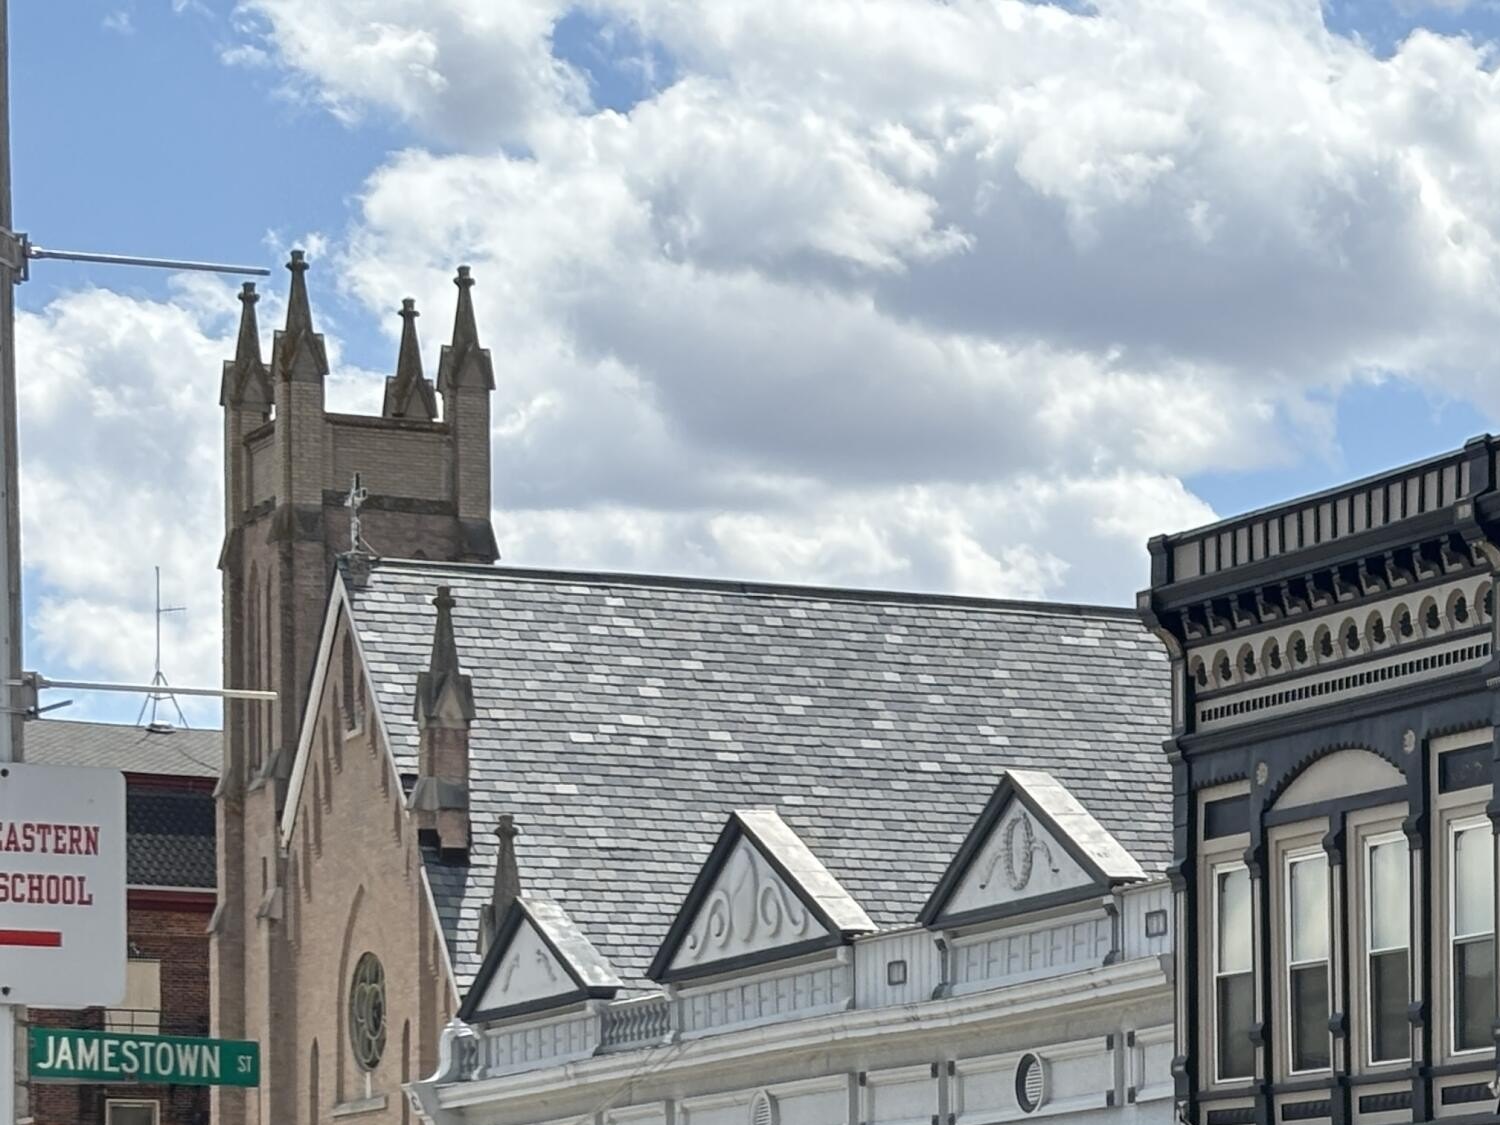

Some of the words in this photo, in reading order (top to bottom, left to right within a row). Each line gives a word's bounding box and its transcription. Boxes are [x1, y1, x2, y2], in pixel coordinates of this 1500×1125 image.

[0, 821, 100, 856] ASTERN
[0, 872, 94, 906] SCHOOL
[37, 1035, 221, 1079] JAMESTOWN
[237, 1055, 253, 1073] ST
